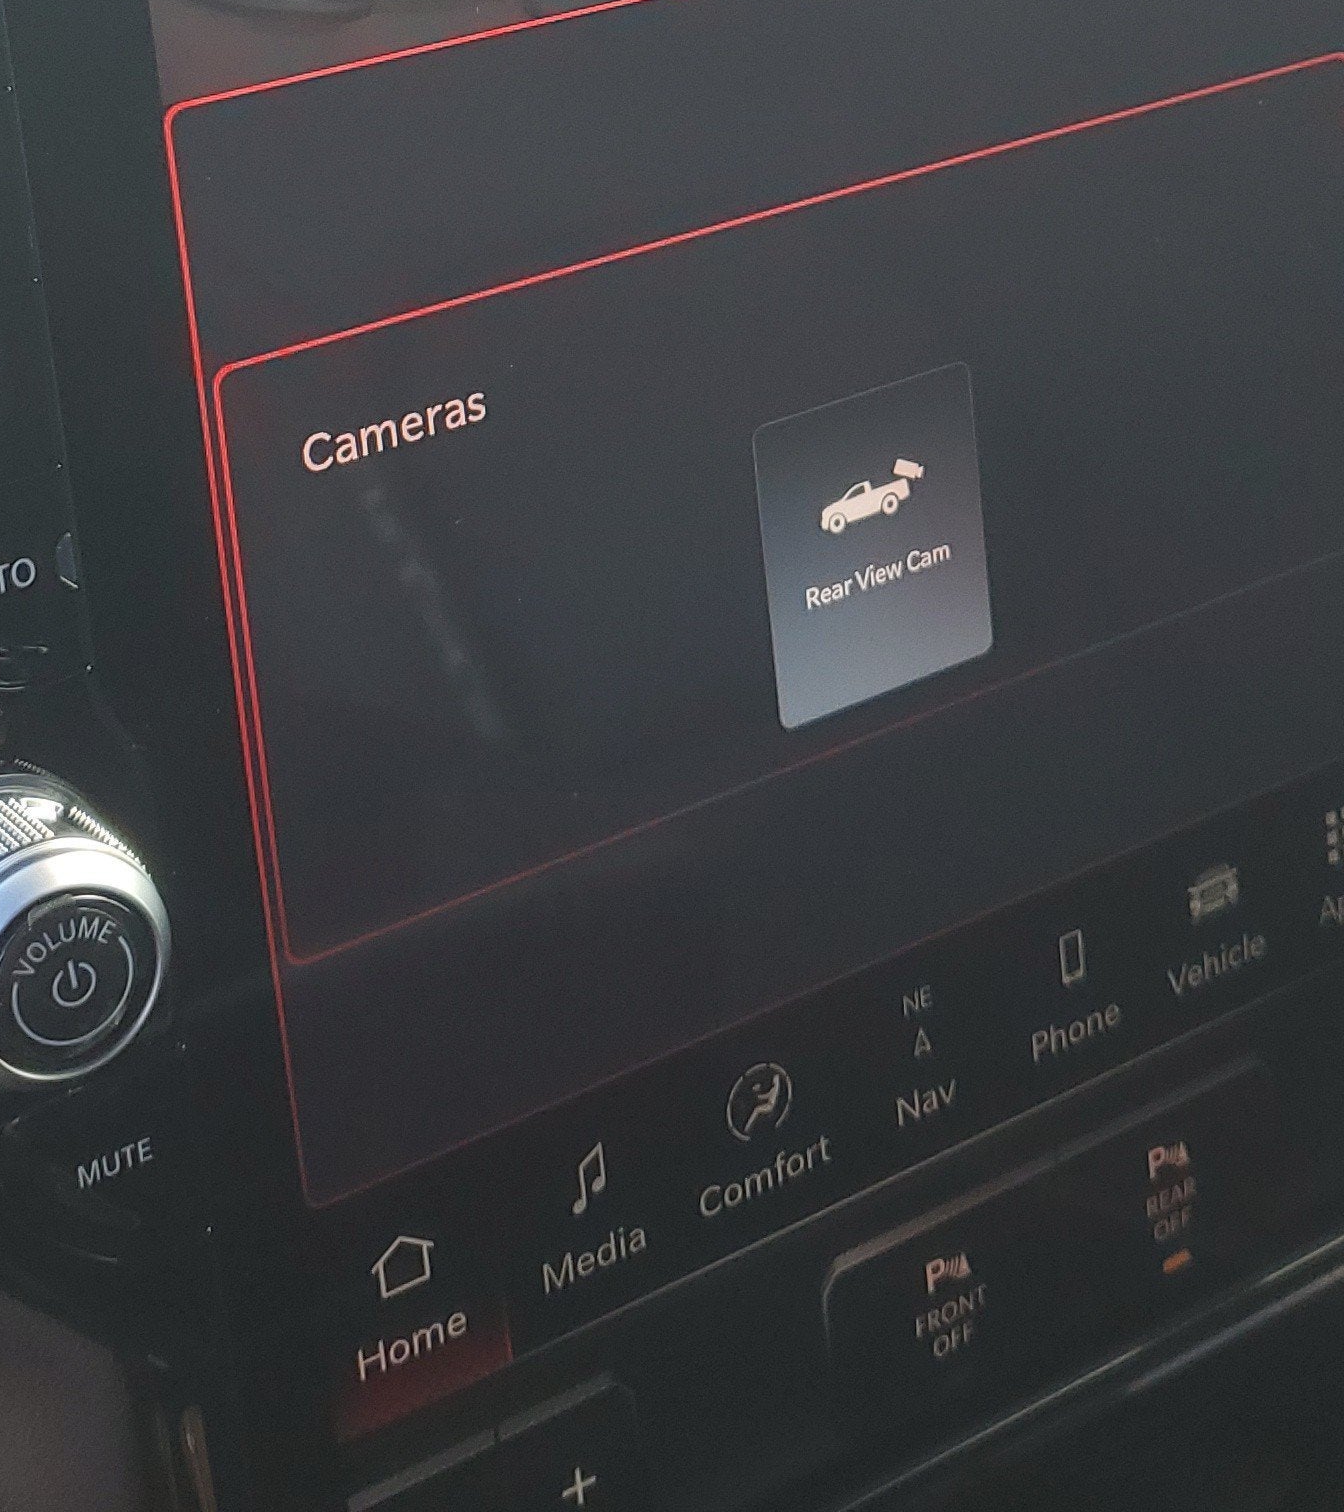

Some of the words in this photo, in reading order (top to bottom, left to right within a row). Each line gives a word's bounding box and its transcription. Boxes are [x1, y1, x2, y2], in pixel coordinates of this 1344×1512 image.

[302, 392, 488, 472] Cameras
[805, 578, 853, 610] Rear
[855, 560, 903, 592] View
[906, 543, 951, 572] Cam
[13, 916, 118, 979] VOLUME
[1168, 932, 1266, 995] Vehicle
[902, 986, 932, 1015] NE
[1031, 1001, 1121, 1062] Phone
[895, 1080, 957, 1126] Nav
[76, 1137, 154, 1188] MUTE
[698, 1135, 832, 1218] Comfort
[542, 1226, 646, 1294] Media
[914, 1285, 987, 1338] FRONT
[932, 1322, 974, 1357] OFF
[356, 1310, 468, 1381] Home
